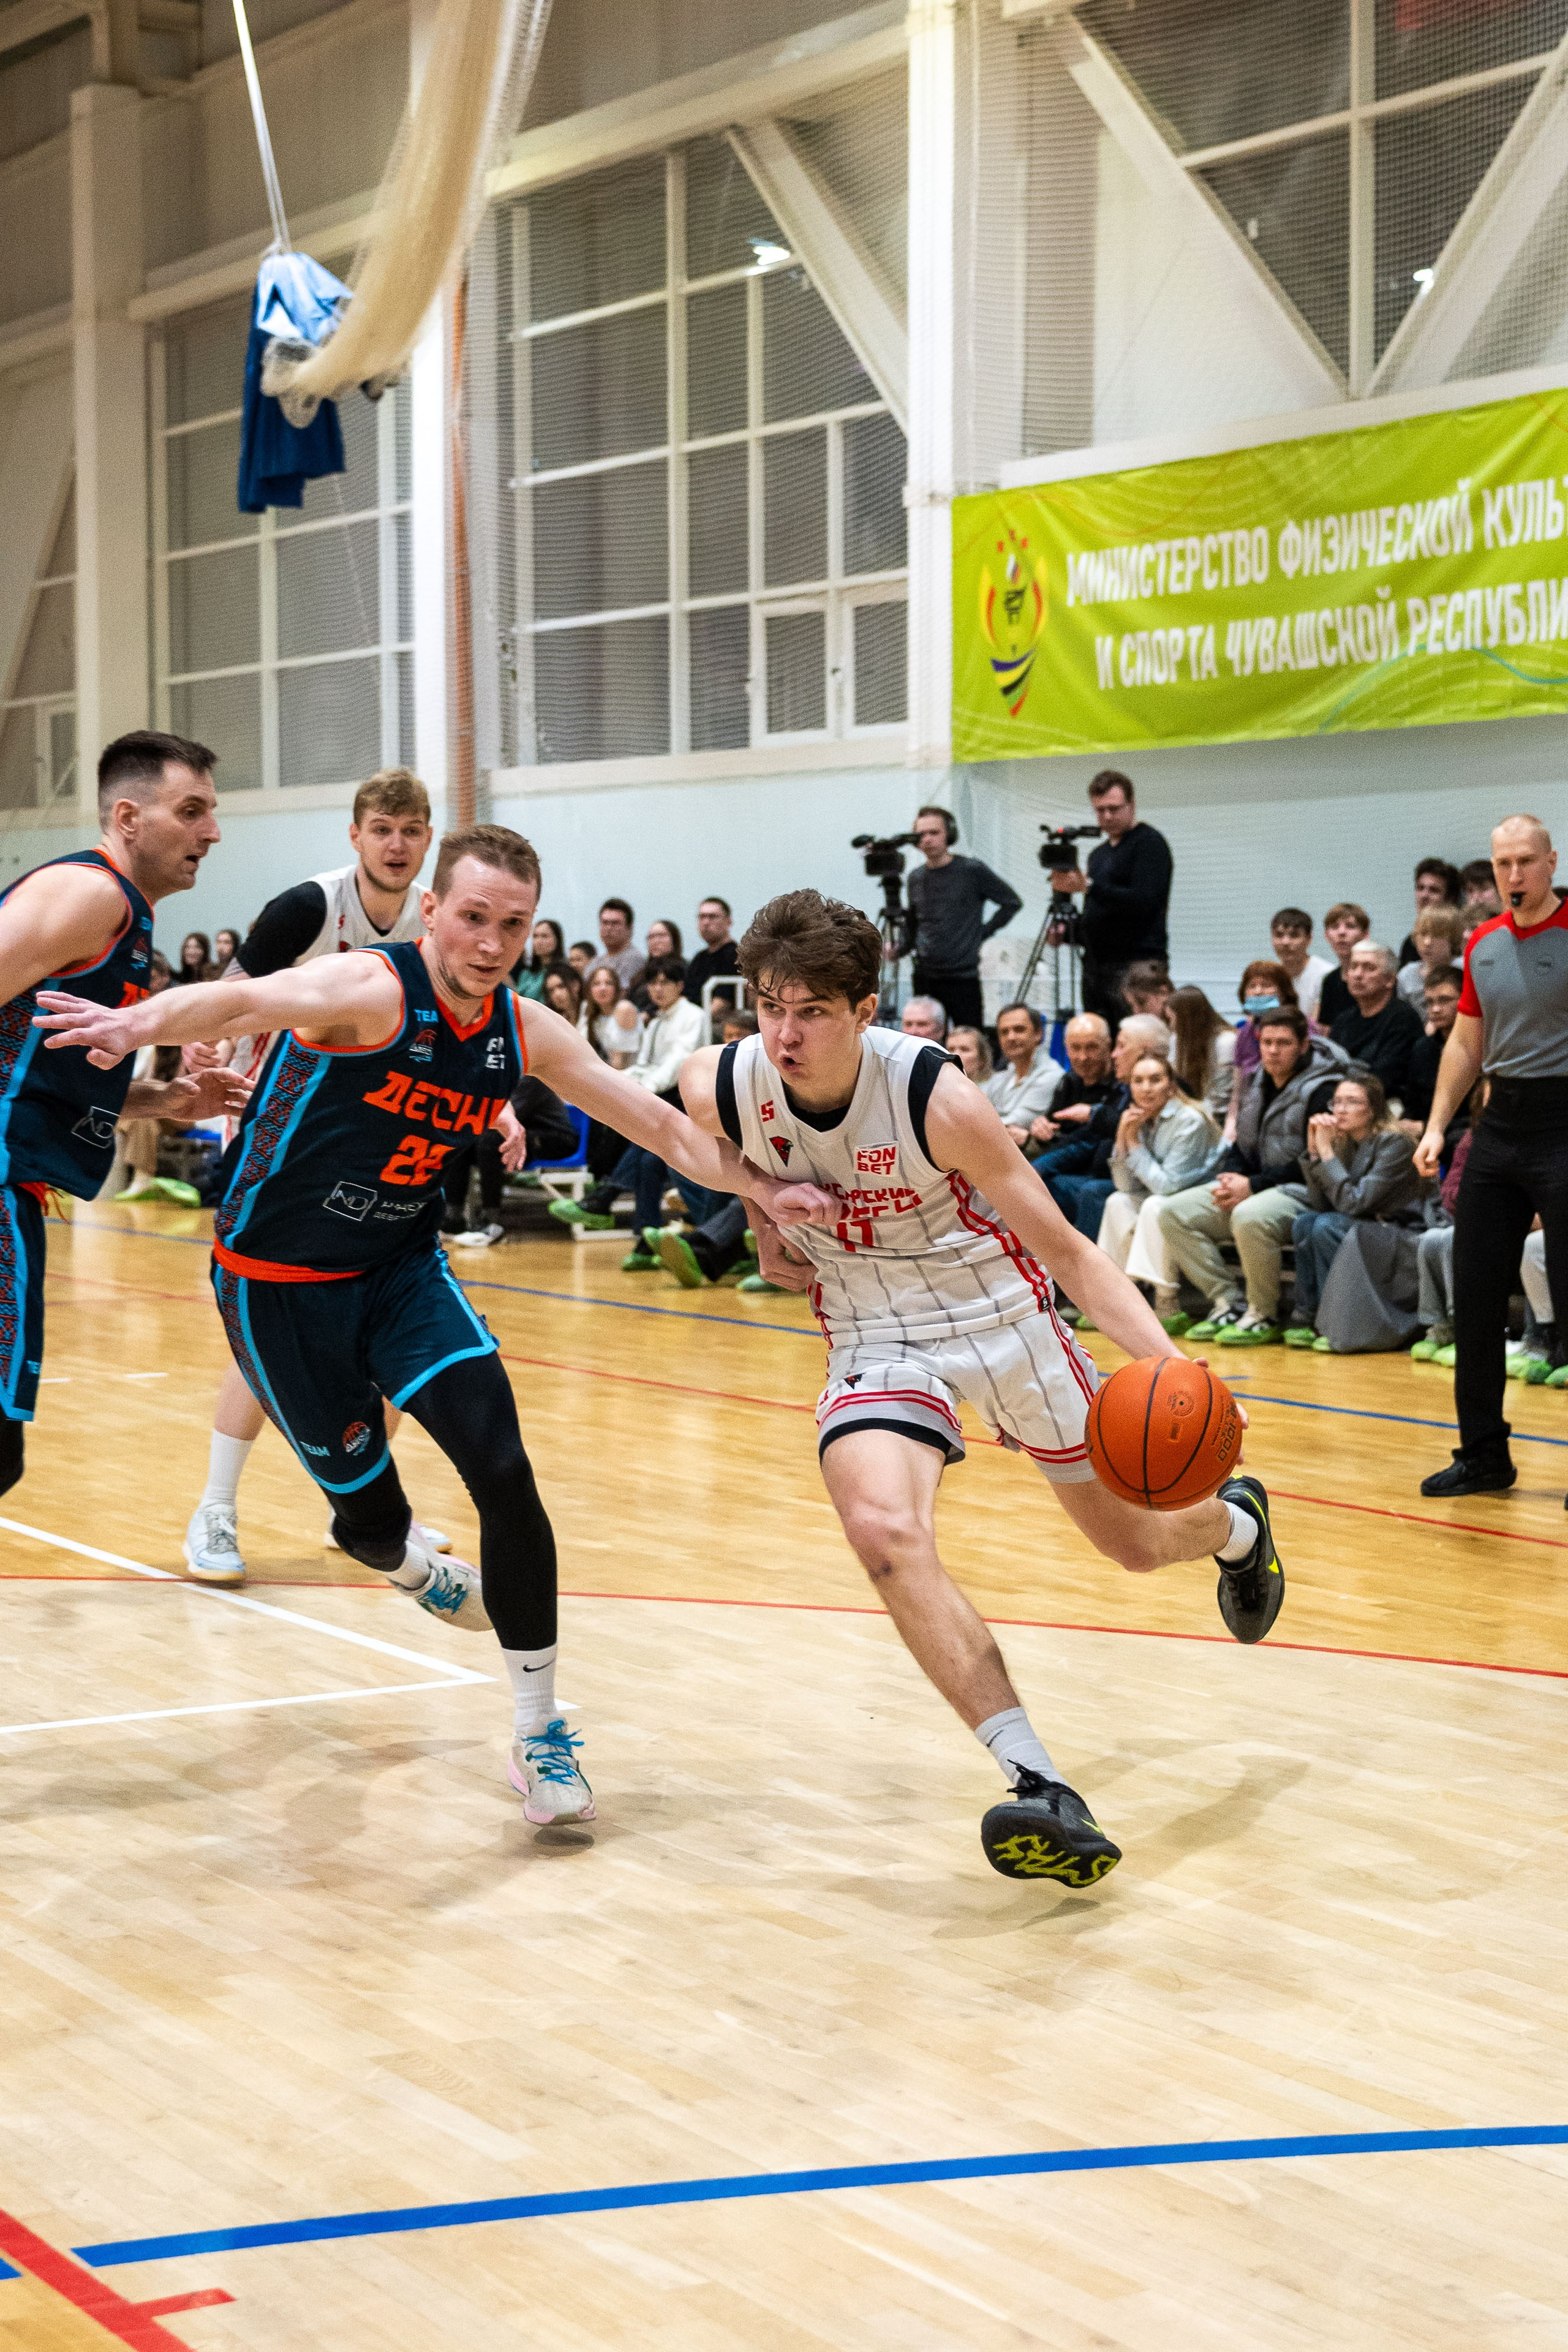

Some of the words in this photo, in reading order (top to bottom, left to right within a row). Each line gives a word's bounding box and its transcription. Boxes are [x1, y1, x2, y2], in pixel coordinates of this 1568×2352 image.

[1066, 526, 1269, 607] МИНИСТЕРСТВО
[1278, 478, 1472, 579] ФИЗИЧЕСКОЙ
[1482, 475, 1568, 549] КУЛЬ
[1120, 624, 1218, 687] СПОРТА
[1226, 585, 1399, 677] ЧУВАШСКОЙ
[858, 1147, 896, 1163] FON
[858, 1161, 895, 1175] BET
